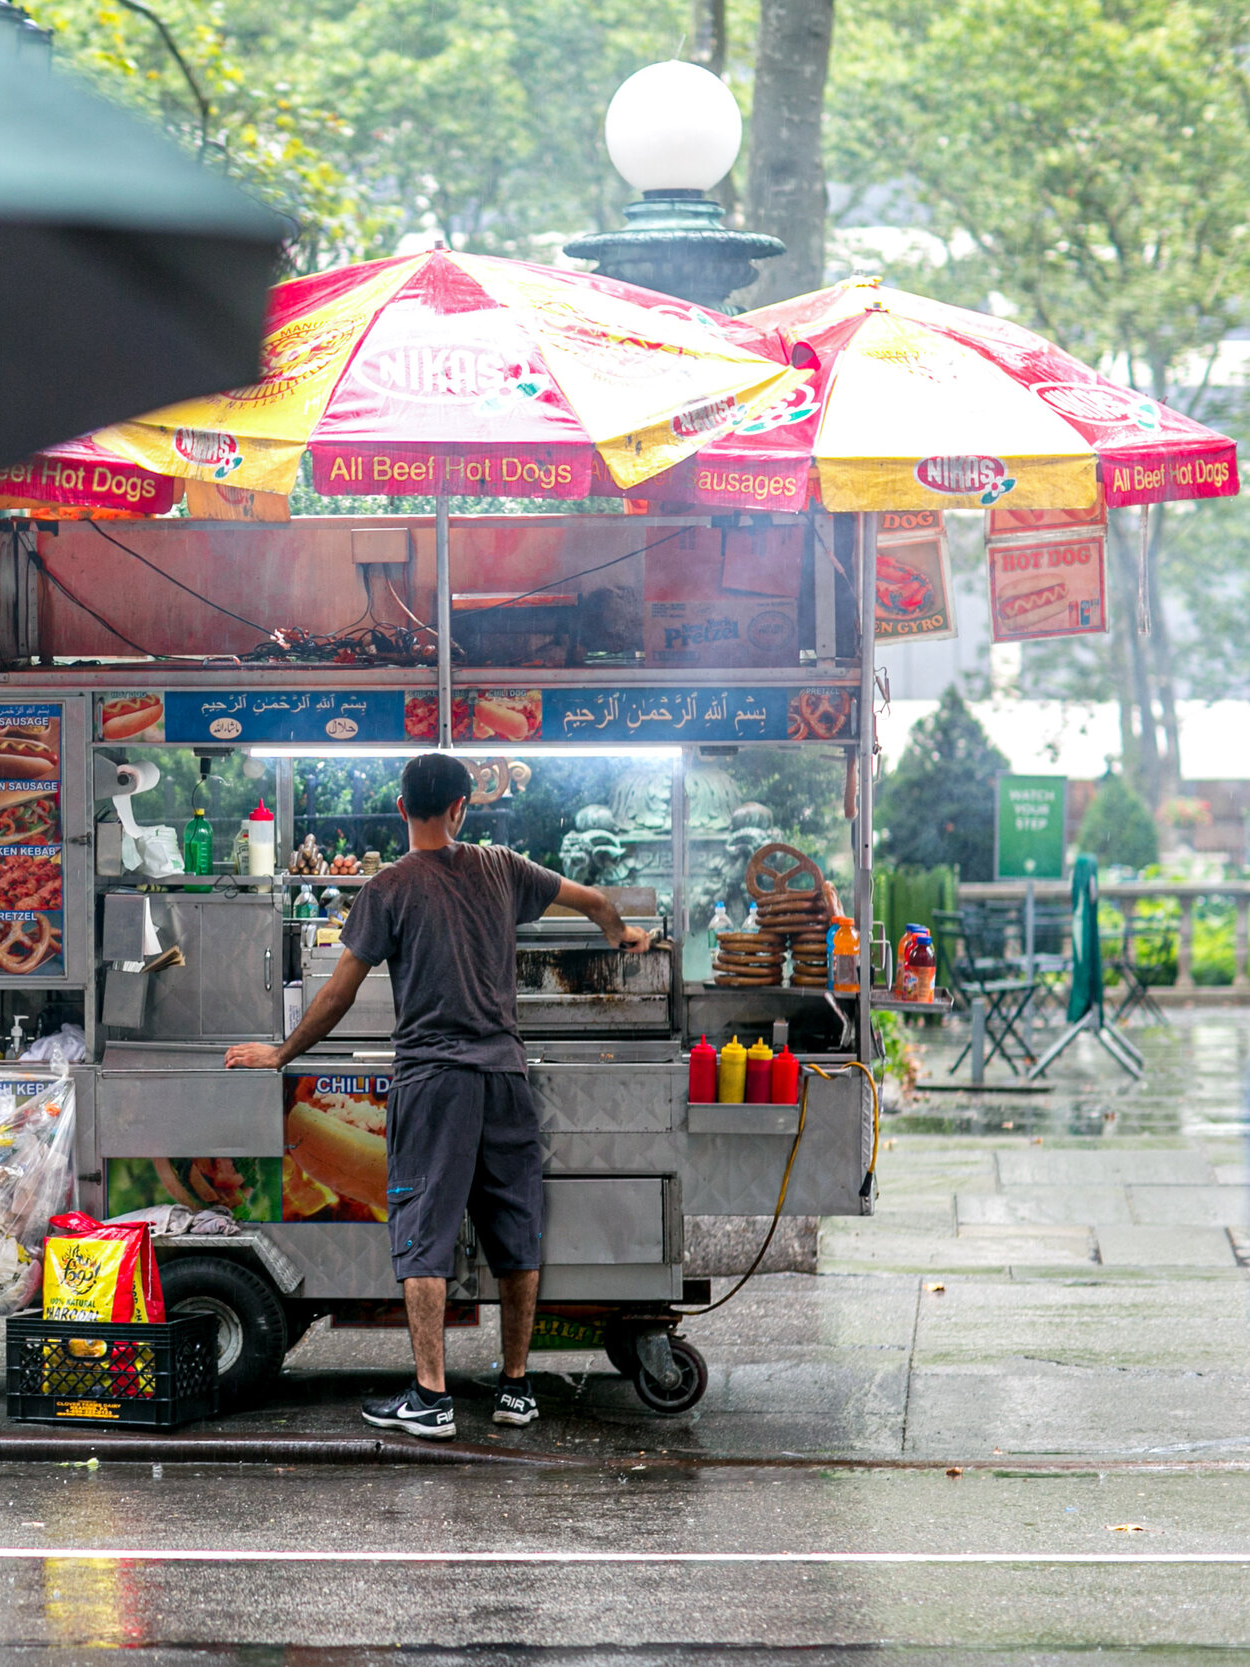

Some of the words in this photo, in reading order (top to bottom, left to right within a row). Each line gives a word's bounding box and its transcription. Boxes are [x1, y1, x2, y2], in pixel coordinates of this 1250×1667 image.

[378, 349, 501, 394] NIKAS
[329, 456, 363, 481] All
[372, 455, 436, 481] Beef
[445, 456, 492, 481] Hot
[501, 456, 573, 489] Dogs
[925, 455, 996, 487] NIKAS
[1113, 468, 1131, 493] All
[1134, 462, 1166, 490] Beef
[1170, 462, 1194, 487] Hot
[1196, 460, 1230, 489] Dogs
[41, 462, 84, 490] Hot
[92, 467, 156, 503] Dogs
[882, 511, 934, 529] DOG
[1002, 552, 1042, 572] HOT
[1047, 545, 1093, 568] DOG
[896, 614, 944, 635] GYRO
[664, 619, 740, 650] Pretzel
[8, 782, 58, 792] SAUSAGE
[1008, 789, 1055, 802] WATCH
[1014, 803, 1050, 816] YOUR
[1015, 818, 1048, 831] STEP
[20, 846, 57, 857] KEBAB
[316, 1076, 371, 1095] CHILI
[66, 1298, 96, 1309] NATURAL
[501, 1393, 526, 1412] AIR
